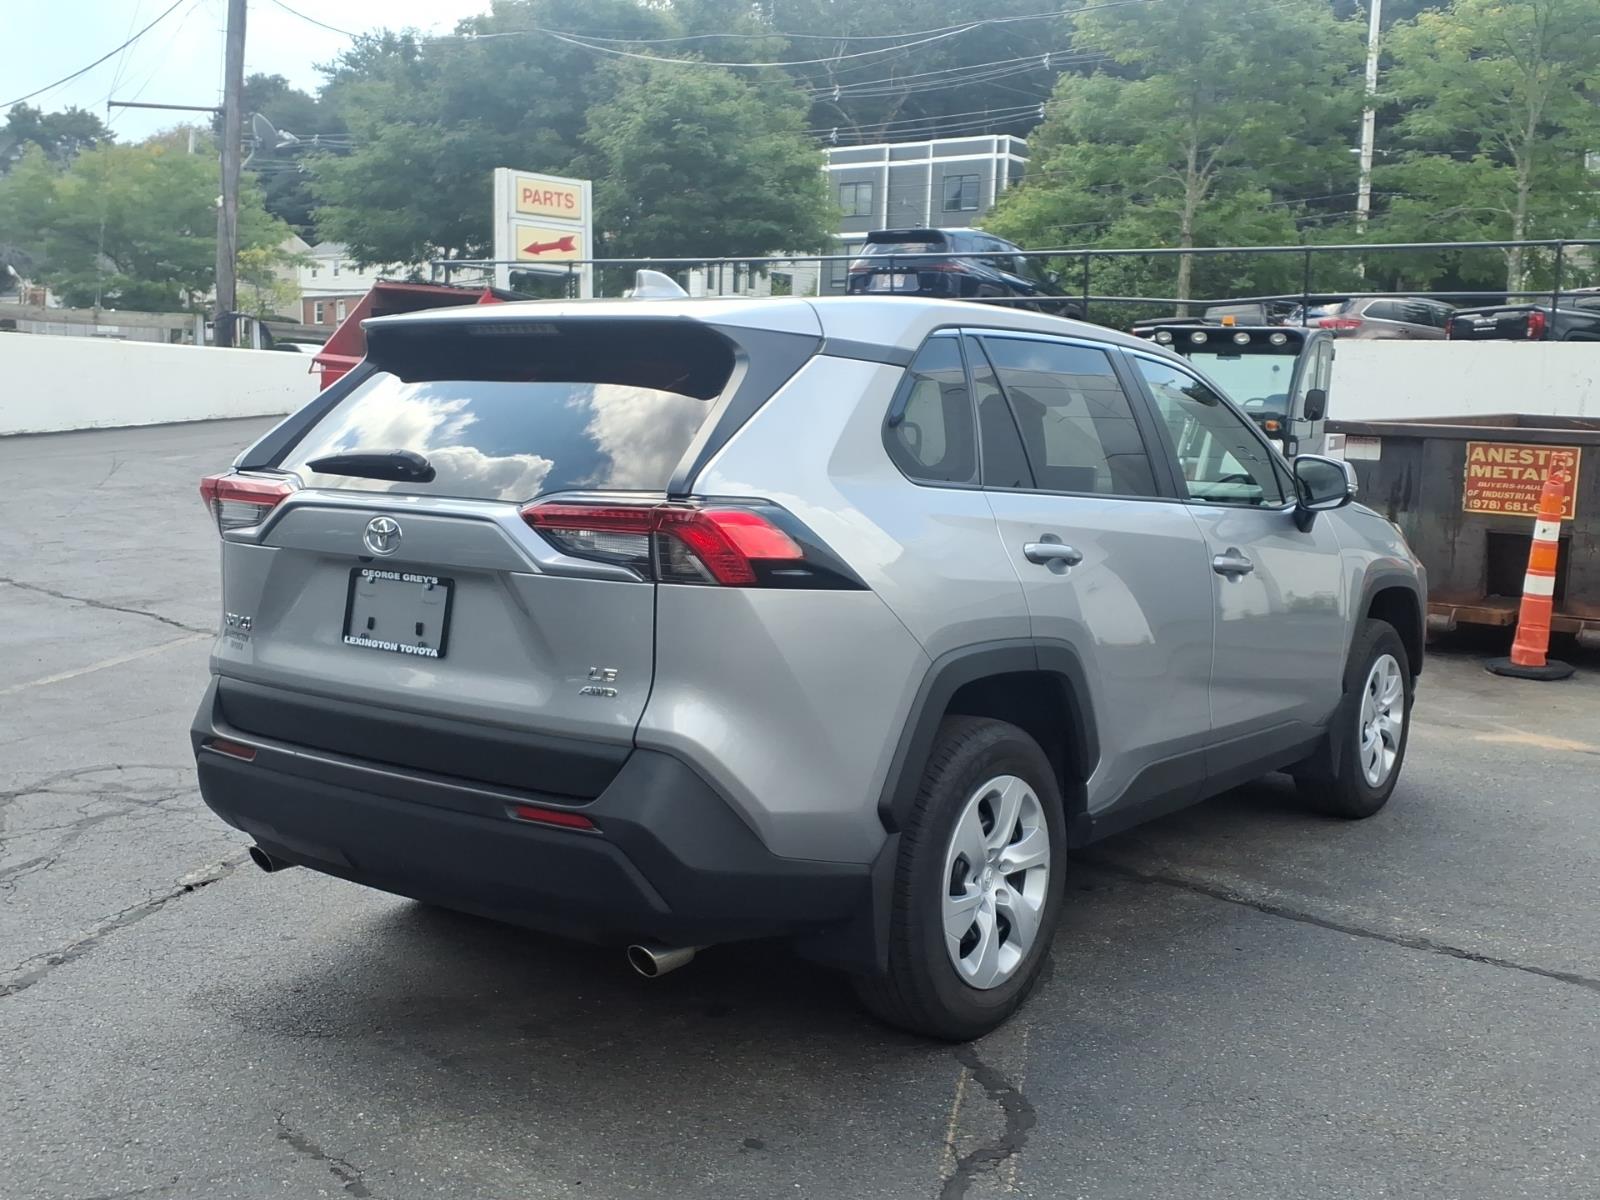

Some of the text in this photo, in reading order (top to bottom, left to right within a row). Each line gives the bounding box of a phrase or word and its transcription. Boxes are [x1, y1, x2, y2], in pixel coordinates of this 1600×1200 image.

[522, 187, 575, 209] PARTS
[1467, 489, 1537, 501] OF INDUSTRIAL
[1469, 499, 1501, 510] (978)
[361, 568, 439, 585] GEORGE GREY'S
[344, 635, 439, 657] LEXINGTON TOYOTA
[578, 685, 618, 697] AWD
